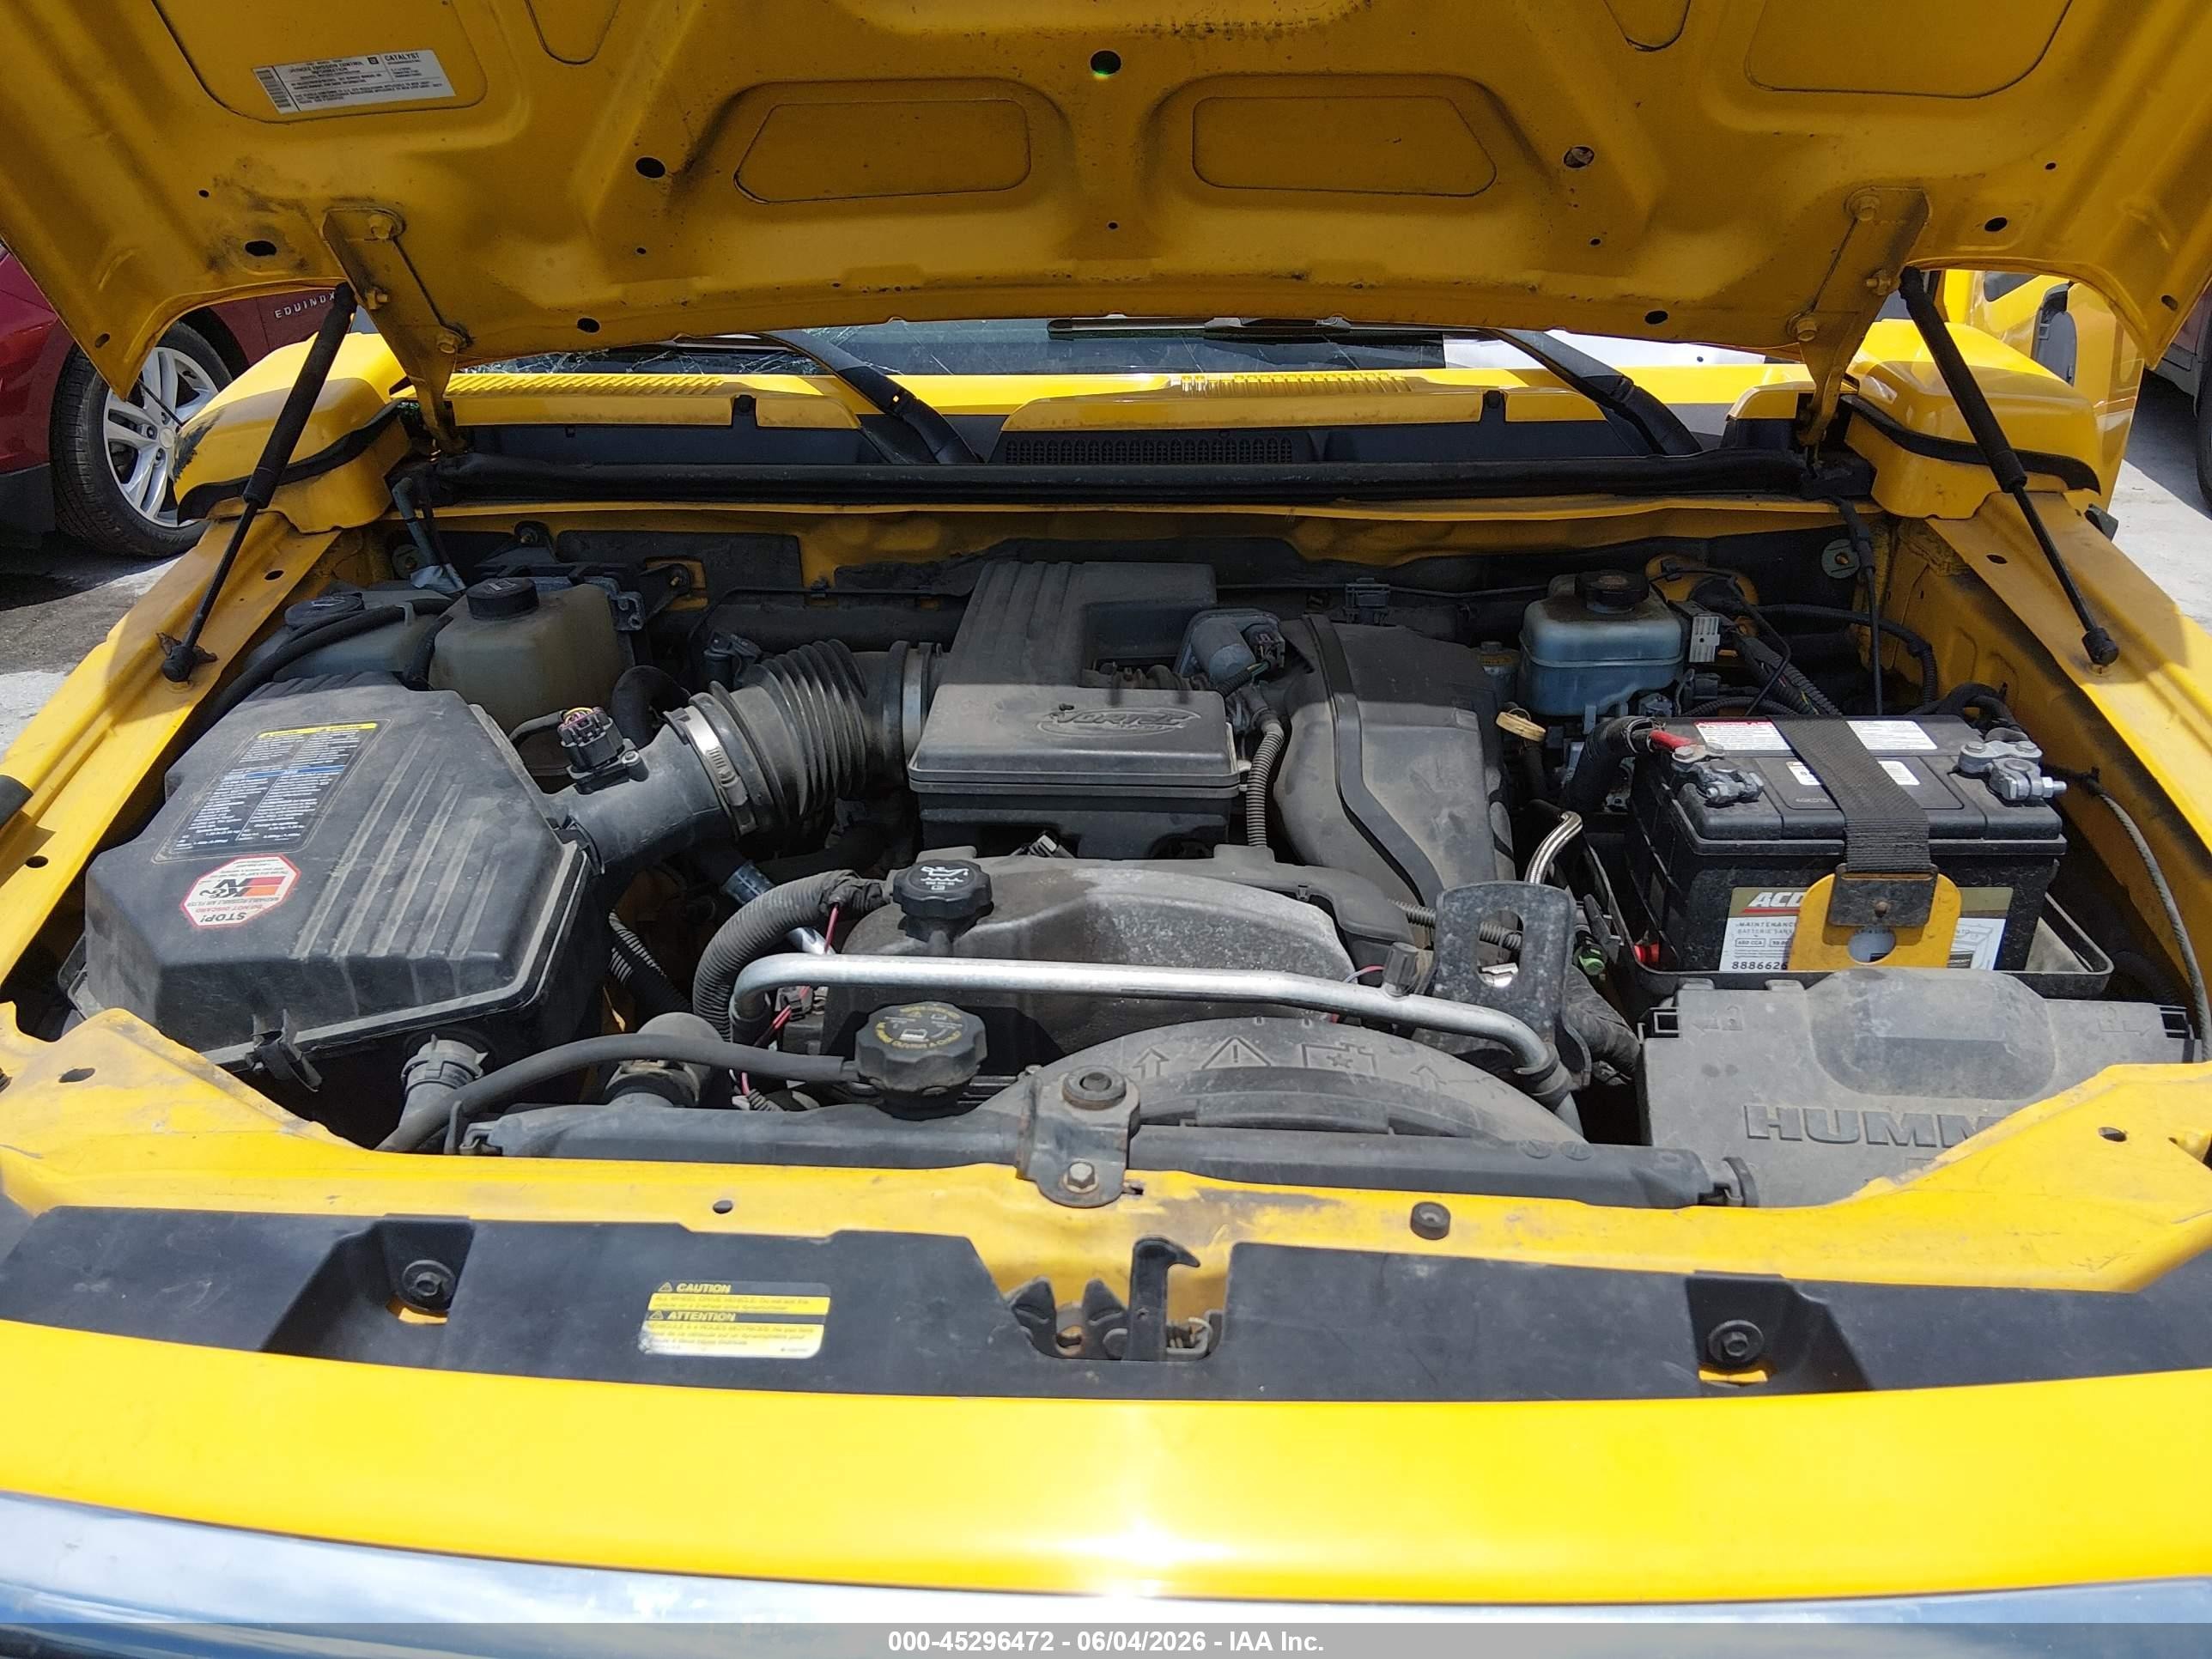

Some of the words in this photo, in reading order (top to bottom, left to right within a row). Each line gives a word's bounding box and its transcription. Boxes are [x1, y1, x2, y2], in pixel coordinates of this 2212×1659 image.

[385, 52, 420, 61] CATALYST
[274, 291, 335, 319] EQUINOX
[200, 912, 247, 923] STOP!
[676, 1283, 732, 1293] CAUTION
[667, 1311, 737, 1322] ATTENTION
